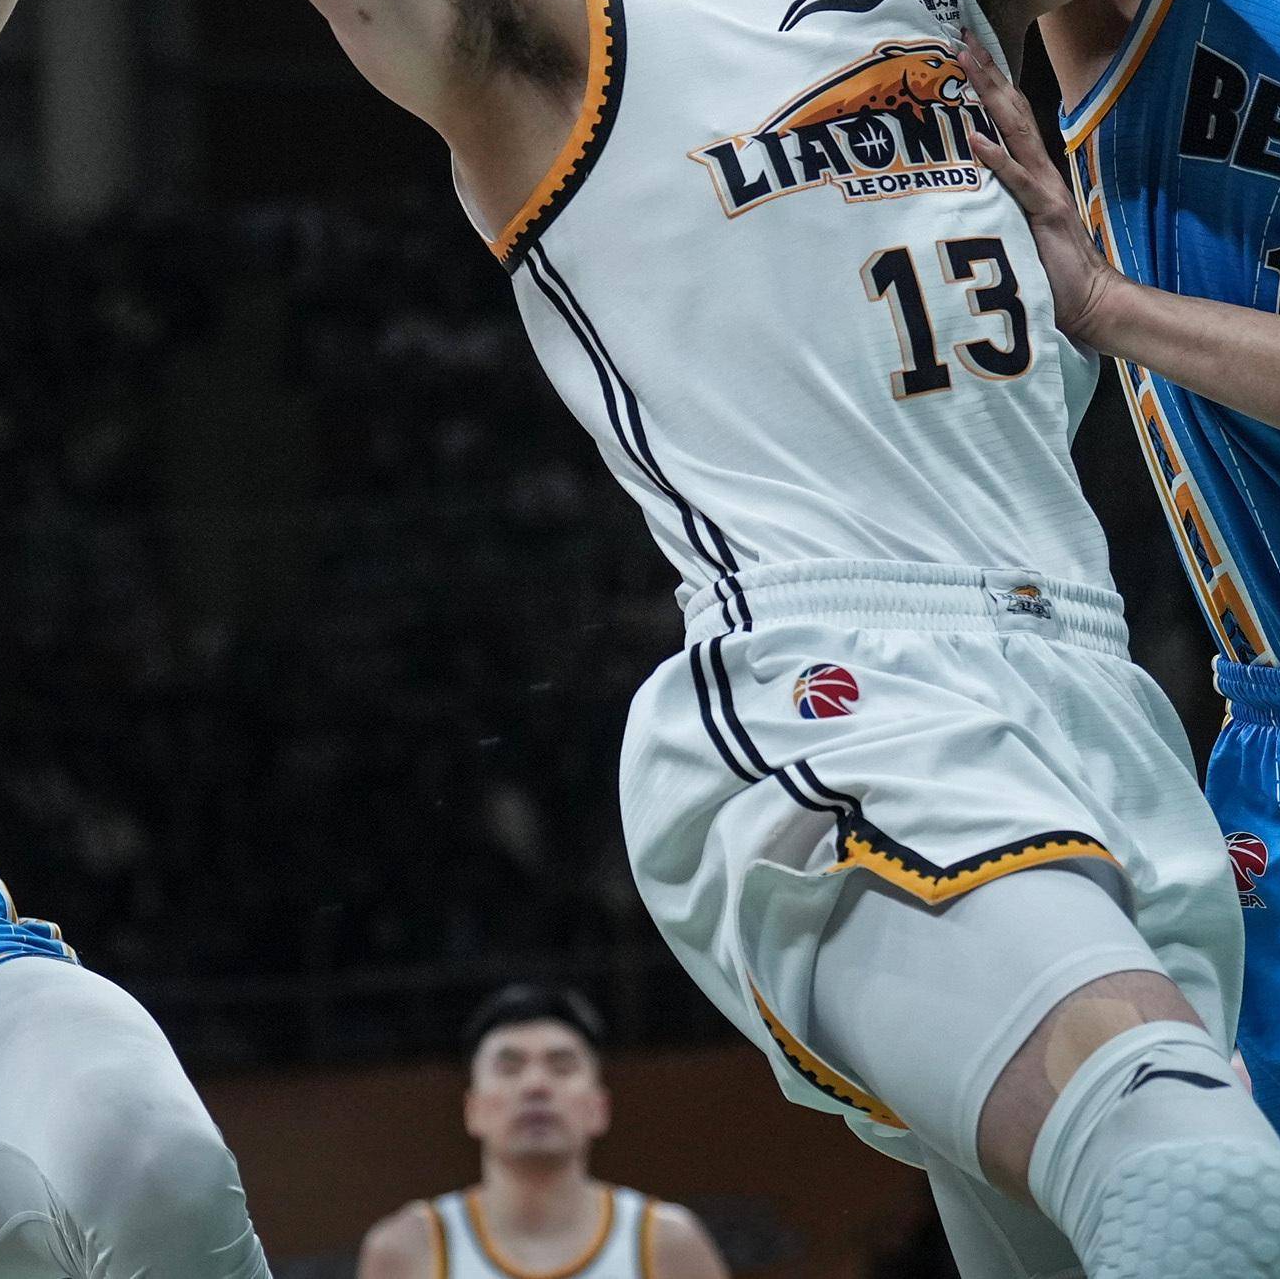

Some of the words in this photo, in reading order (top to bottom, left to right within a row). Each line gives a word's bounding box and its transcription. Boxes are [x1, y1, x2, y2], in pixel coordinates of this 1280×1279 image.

[945, 11, 960, 21] LIFE
[701, 102, 1006, 210] LIAONIN
[845, 167, 978, 197] LEOPARDS
[859, 236, 1033, 401] 13
[1238, 893, 1267, 909] BA
